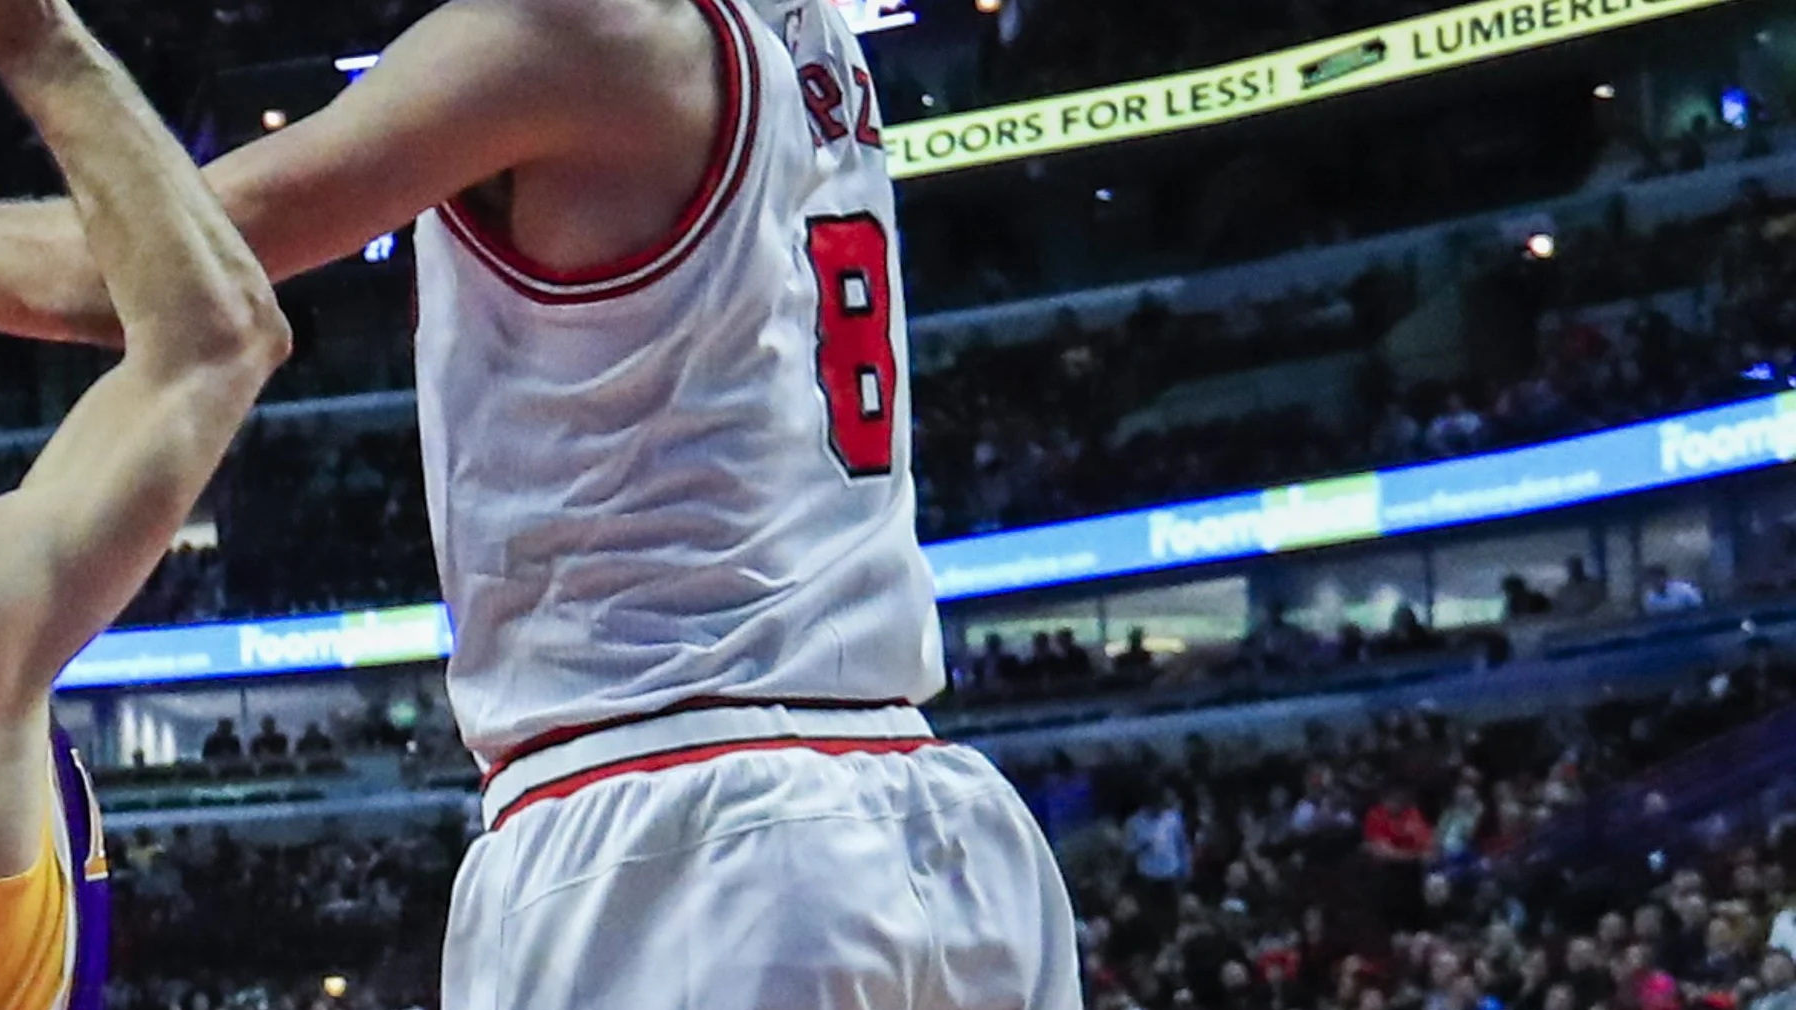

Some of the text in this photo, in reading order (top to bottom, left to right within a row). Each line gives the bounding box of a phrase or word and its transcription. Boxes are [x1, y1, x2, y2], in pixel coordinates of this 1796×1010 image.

[1061, 95, 1147, 135] FOR
[1166, 67, 1275, 117] LESS!
[805, 210, 897, 478] 8
